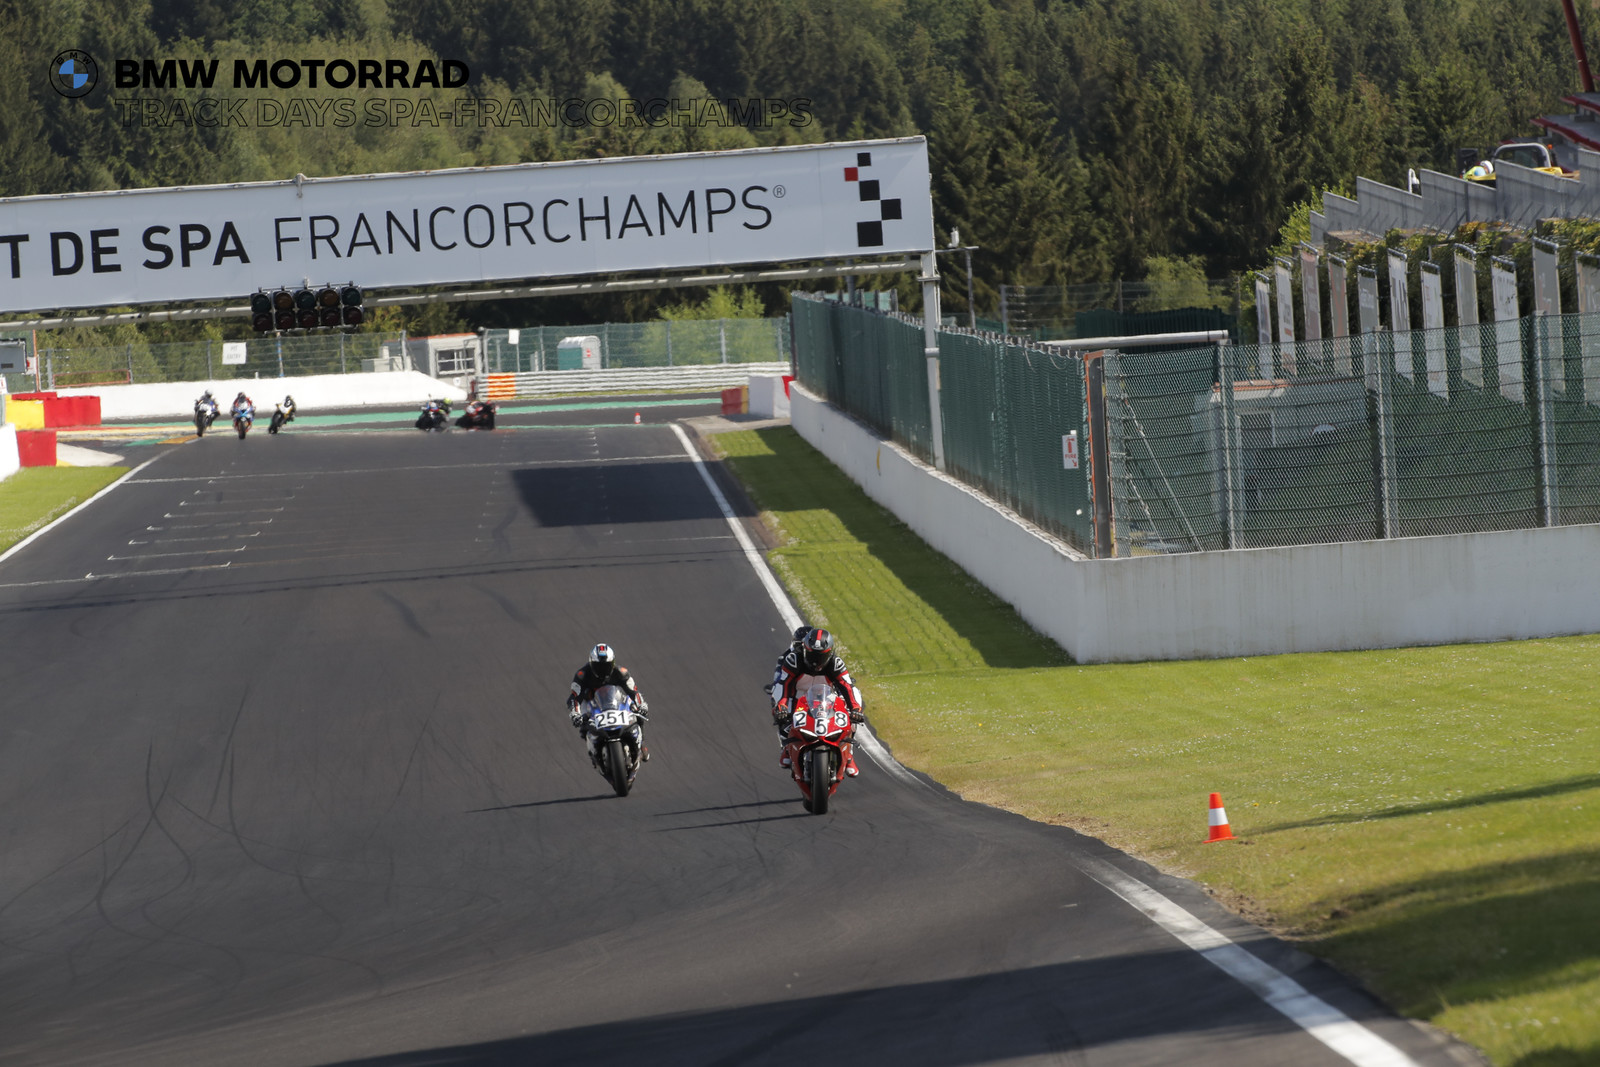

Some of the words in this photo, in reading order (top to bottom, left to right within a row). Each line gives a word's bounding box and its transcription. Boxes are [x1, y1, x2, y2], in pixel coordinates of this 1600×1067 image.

[50, 228, 122, 276] DE
[142, 221, 251, 270] SPA
[275, 185, 773, 262] FRANCORCHAMPS
[595, 711, 626, 727] 251
